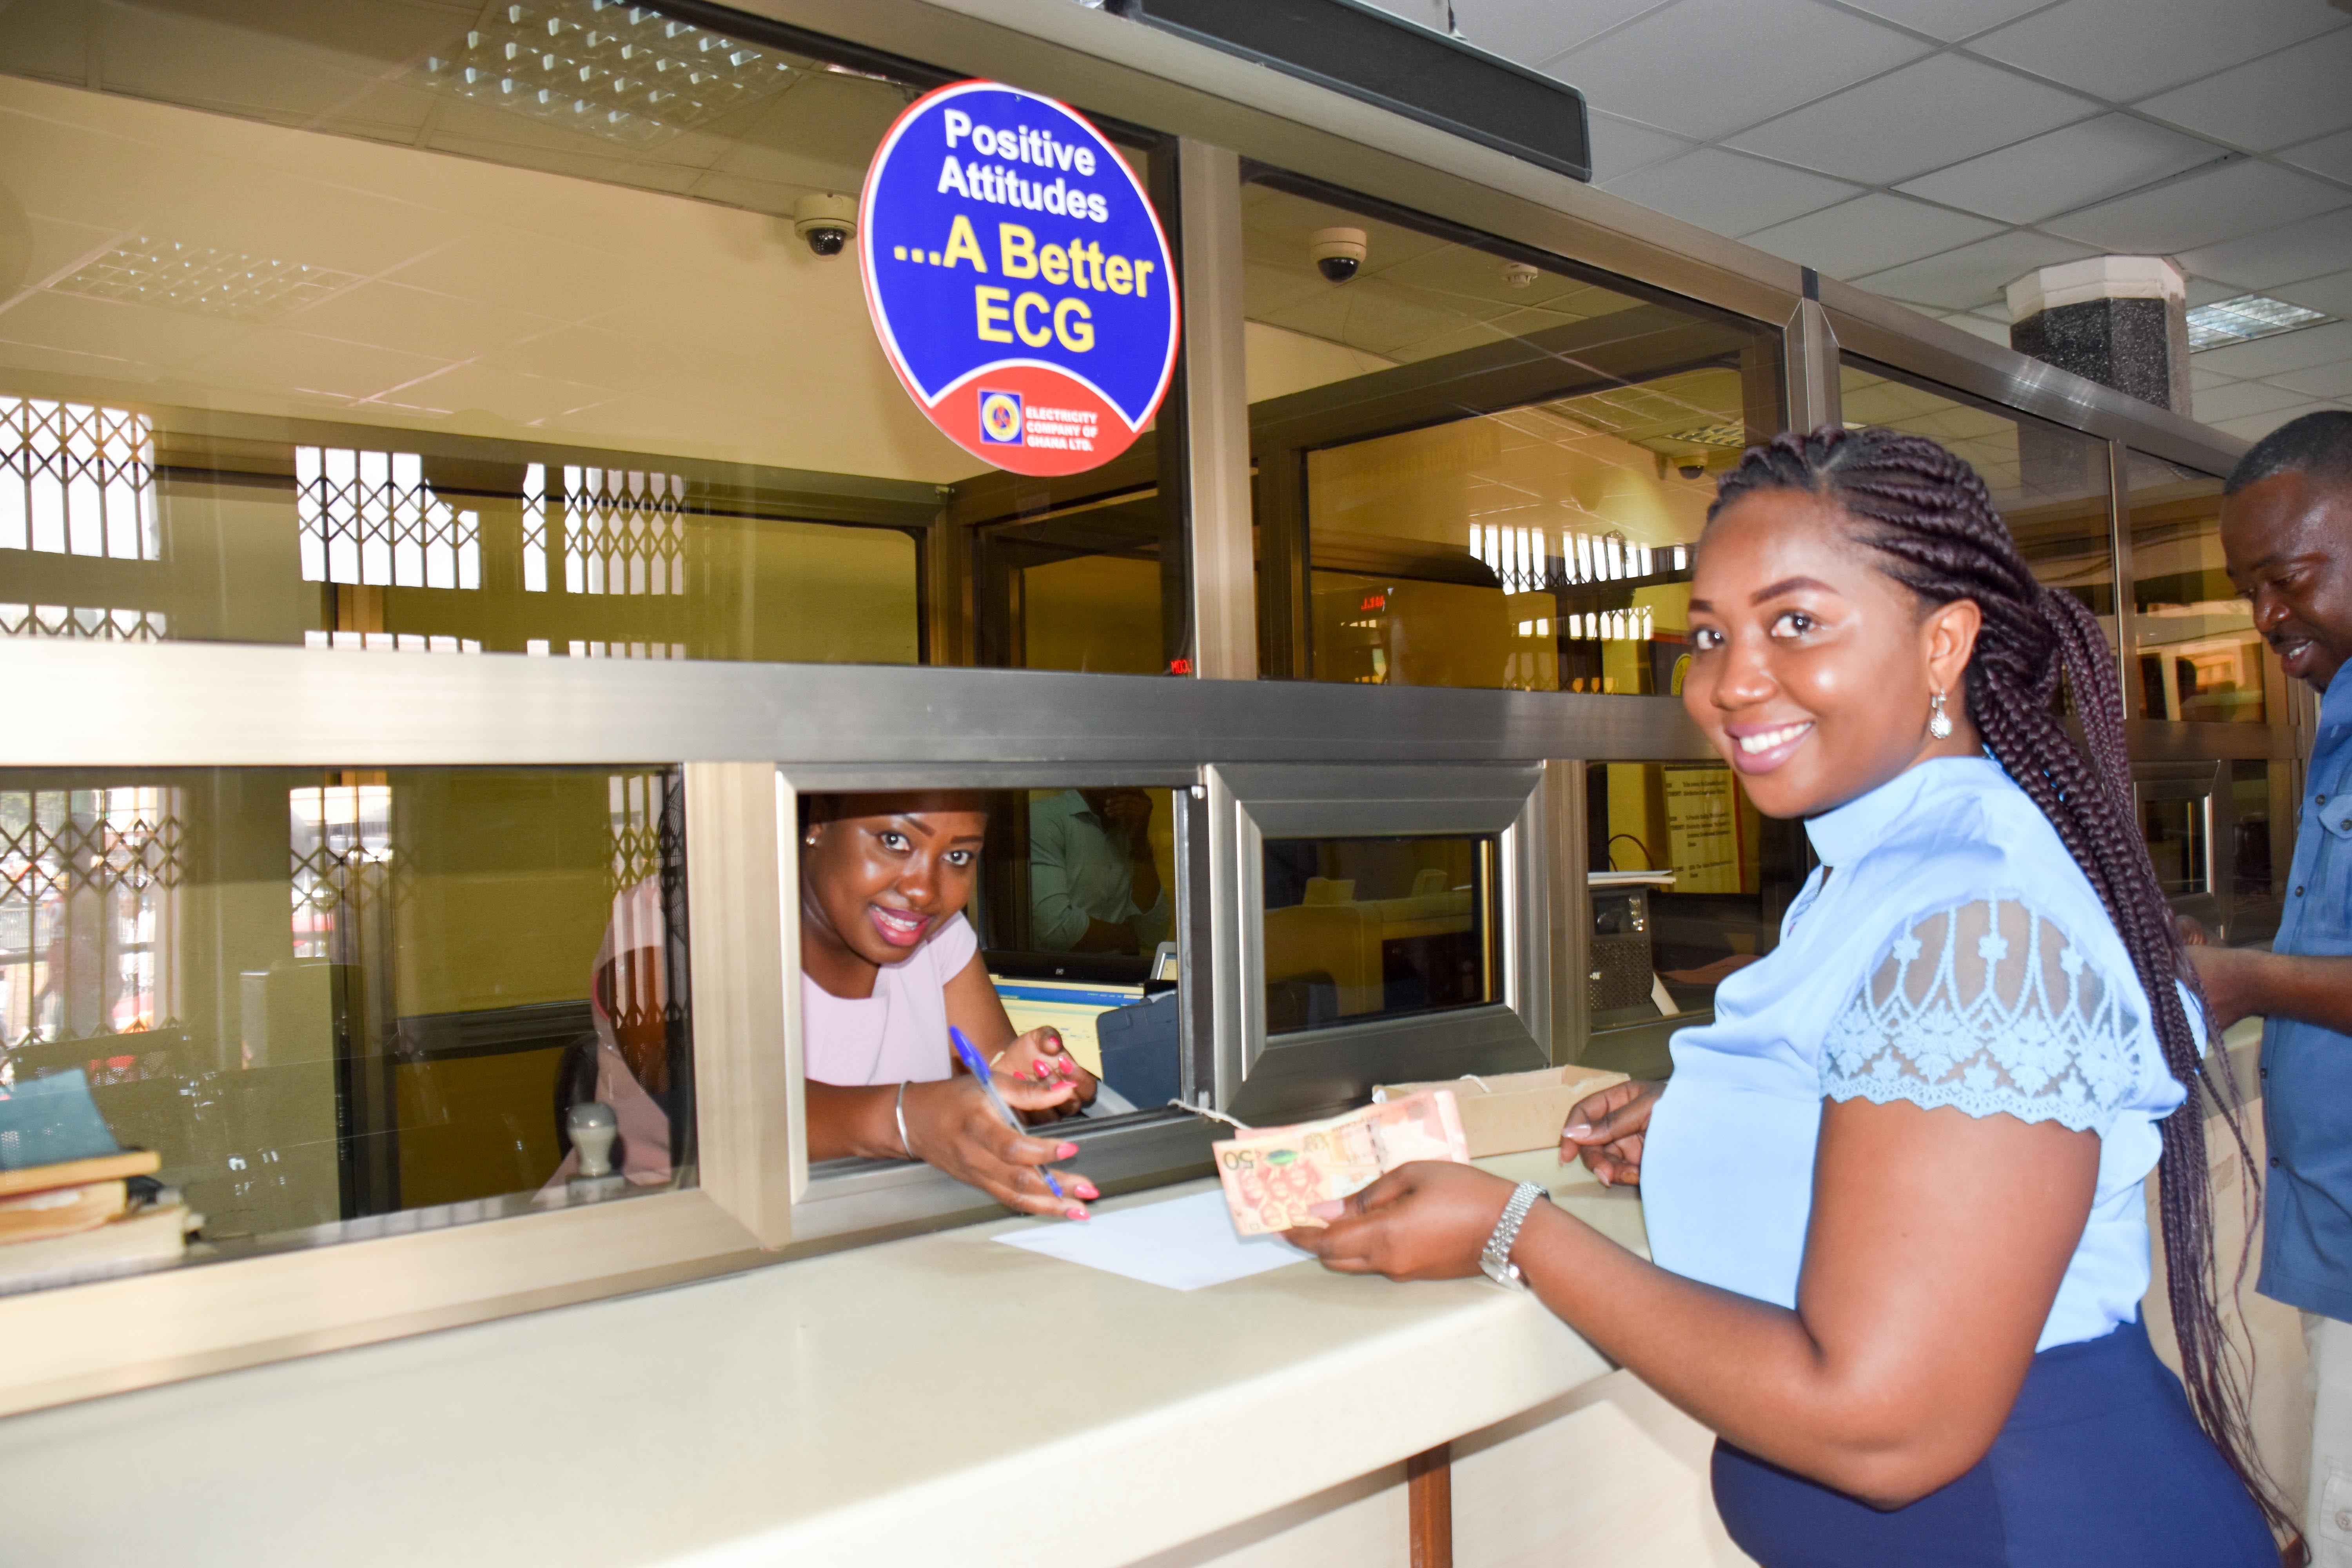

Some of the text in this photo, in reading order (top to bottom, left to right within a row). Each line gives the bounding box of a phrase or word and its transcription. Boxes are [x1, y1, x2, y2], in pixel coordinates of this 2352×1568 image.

[944, 108, 1096, 176] Positive
[938, 155, 1109, 223] Attitudes
[999, 222, 1154, 298] Better
[975, 285, 1095, 353] ECG
[1025, 406, 1098, 425] ELECTRICITY
[1026, 420, 1098, 438] COMPANY OF
[1026, 434, 1094, 452] GHANA LTD.
[1223, 1149, 1254, 1171] 50
